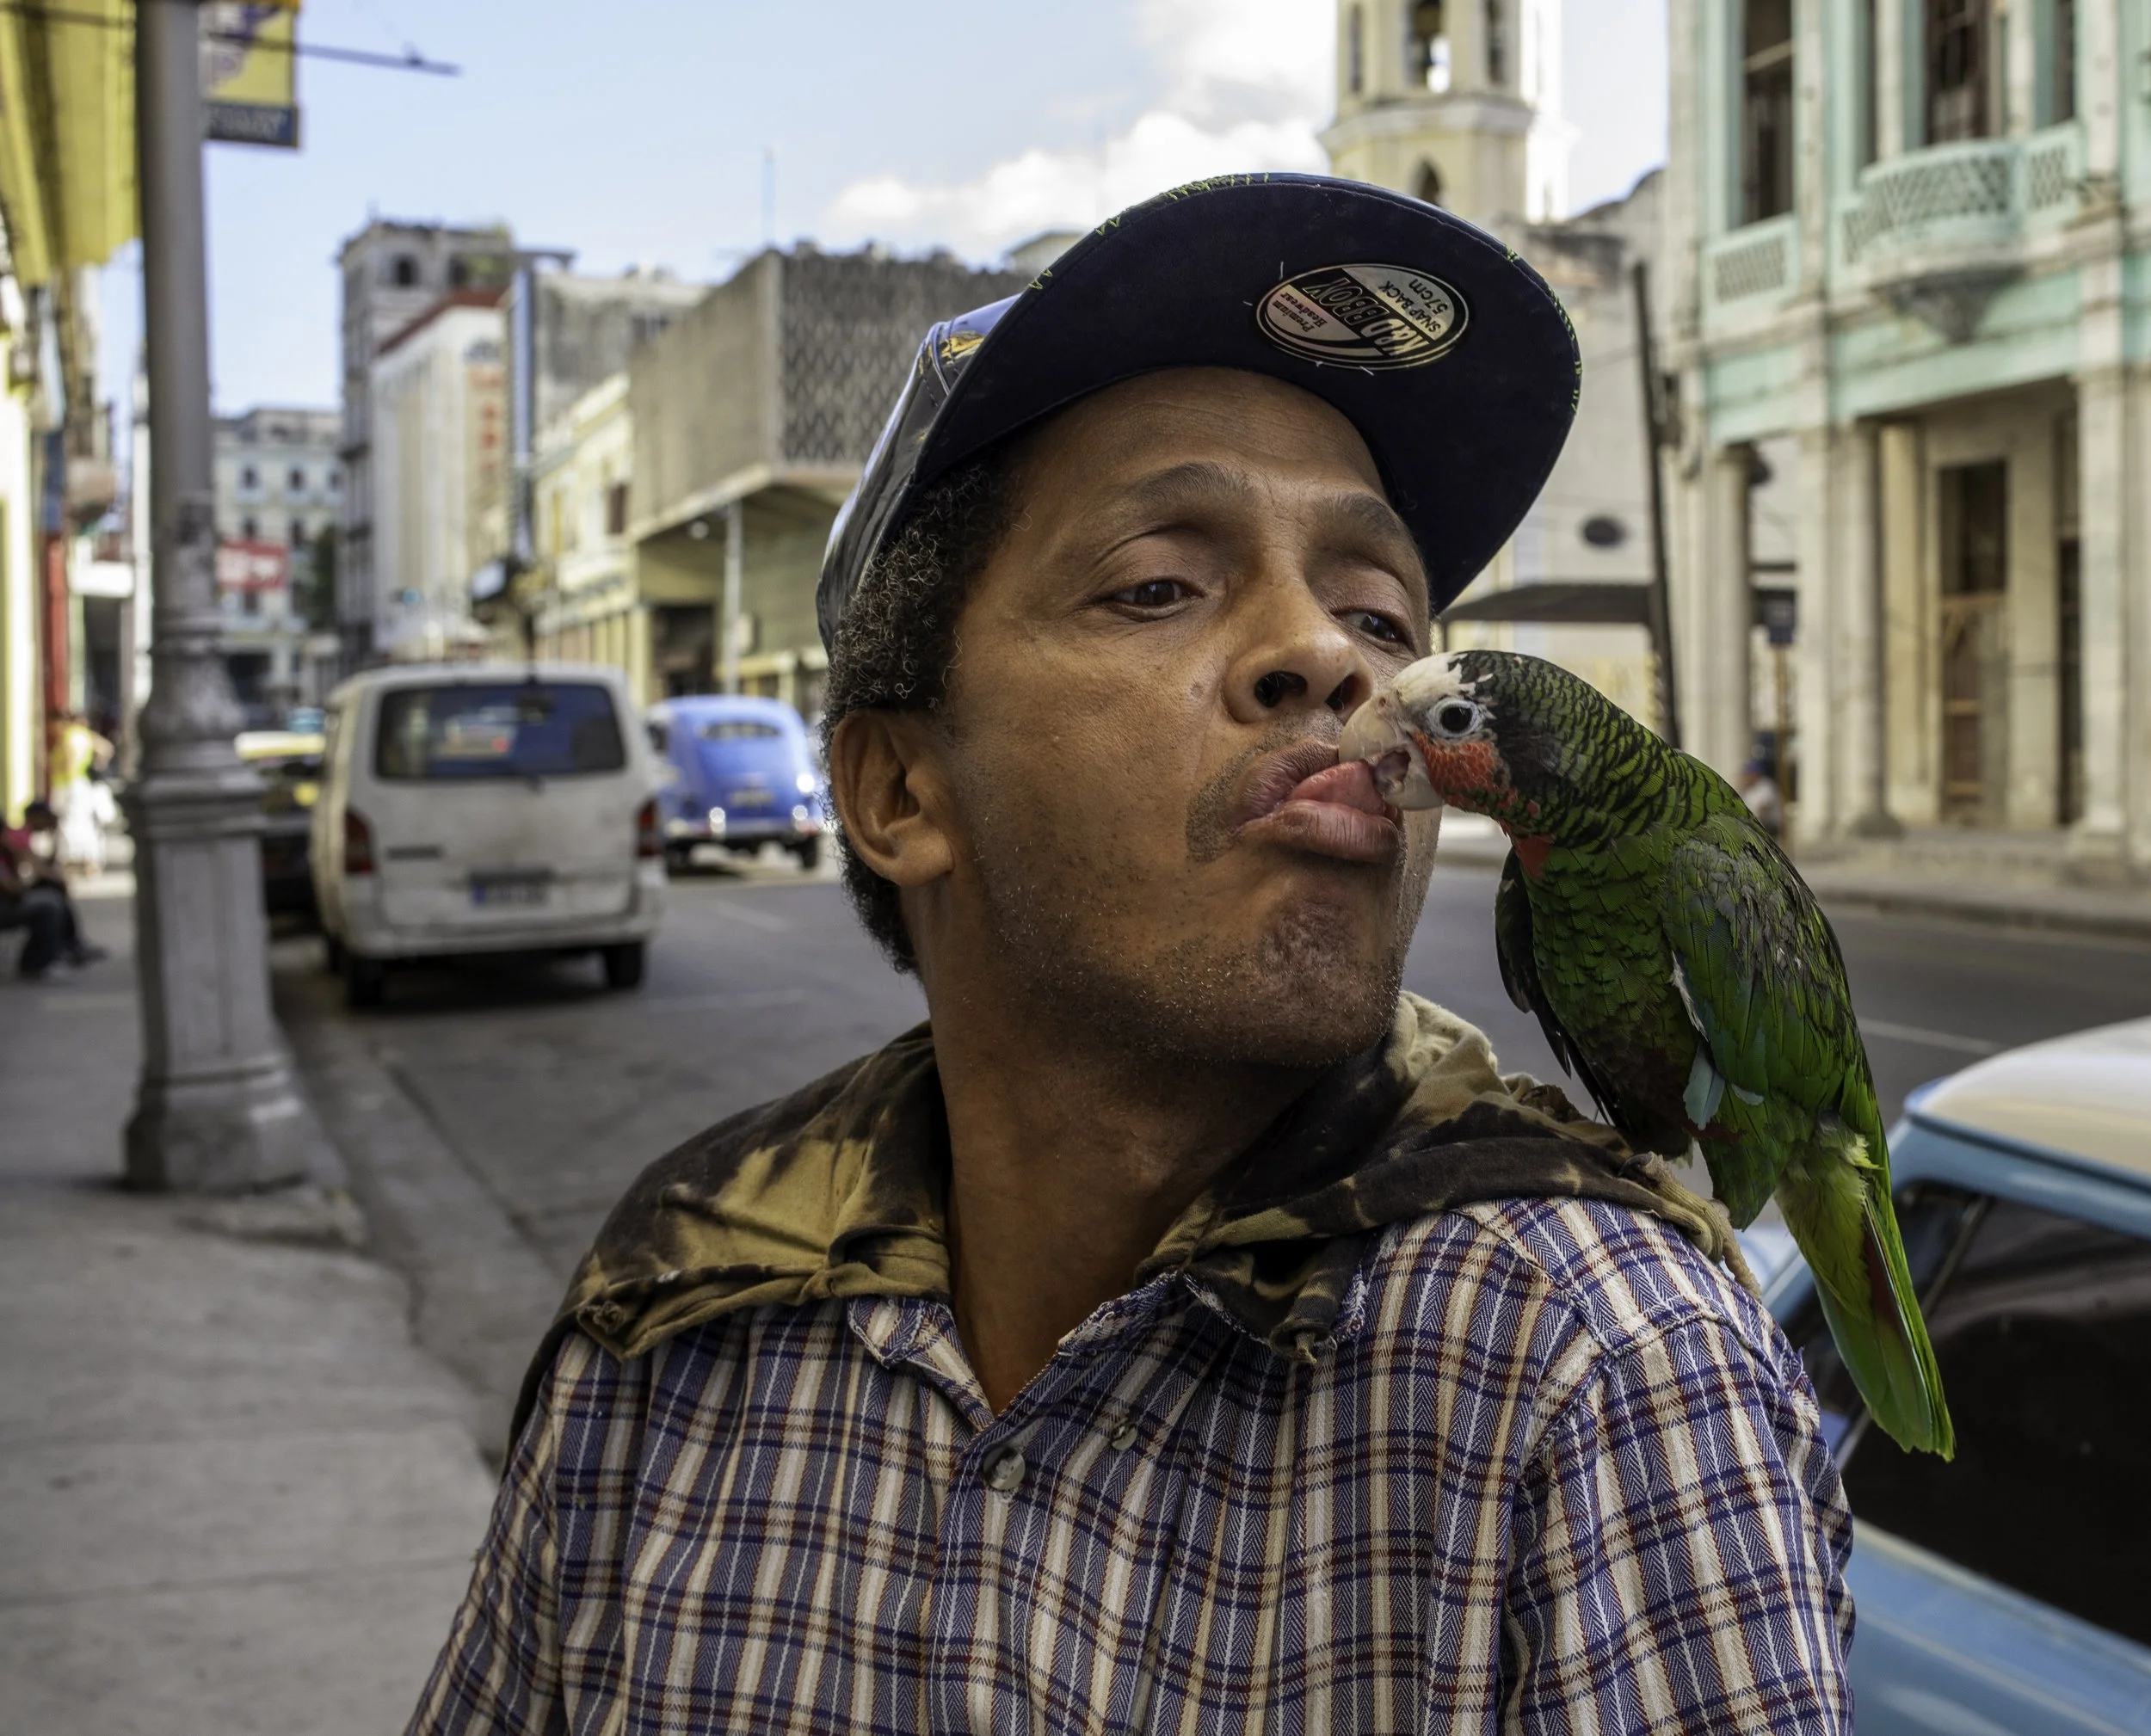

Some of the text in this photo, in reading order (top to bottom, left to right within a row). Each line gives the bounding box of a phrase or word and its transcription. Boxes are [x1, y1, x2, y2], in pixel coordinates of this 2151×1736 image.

[1279, 292, 1328, 328] Headwear
[1378, 280, 1441, 333] SNAP BACK
[1408, 279, 1448, 315] 57cm
[1272, 300, 1316, 334] Premium
[1302, 277, 1431, 356] K&D BBOY
